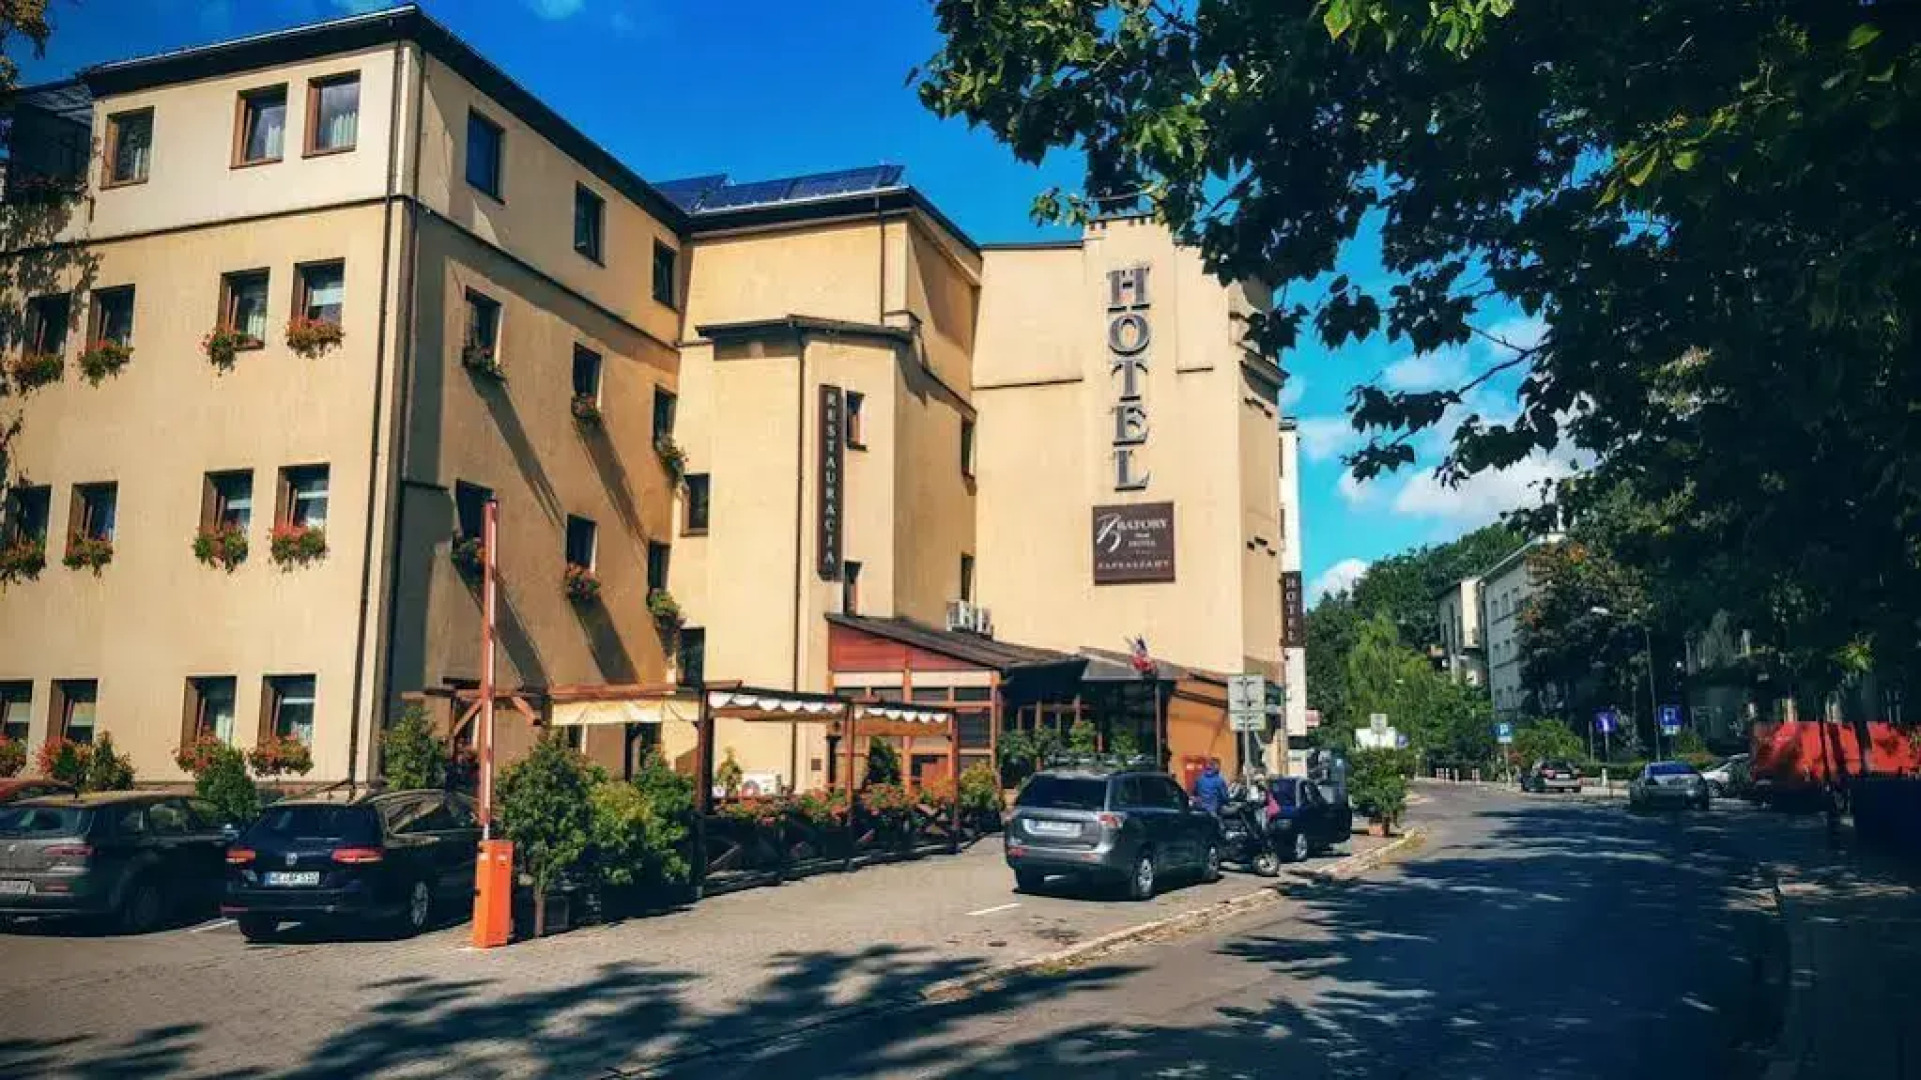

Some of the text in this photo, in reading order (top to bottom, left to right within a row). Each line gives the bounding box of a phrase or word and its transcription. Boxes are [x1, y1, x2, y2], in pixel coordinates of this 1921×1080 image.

[1107, 264, 1150, 491] HOTEL
[825, 391, 837, 567] RESTAURACJA
[1285, 577, 1298, 641] HOTEL
